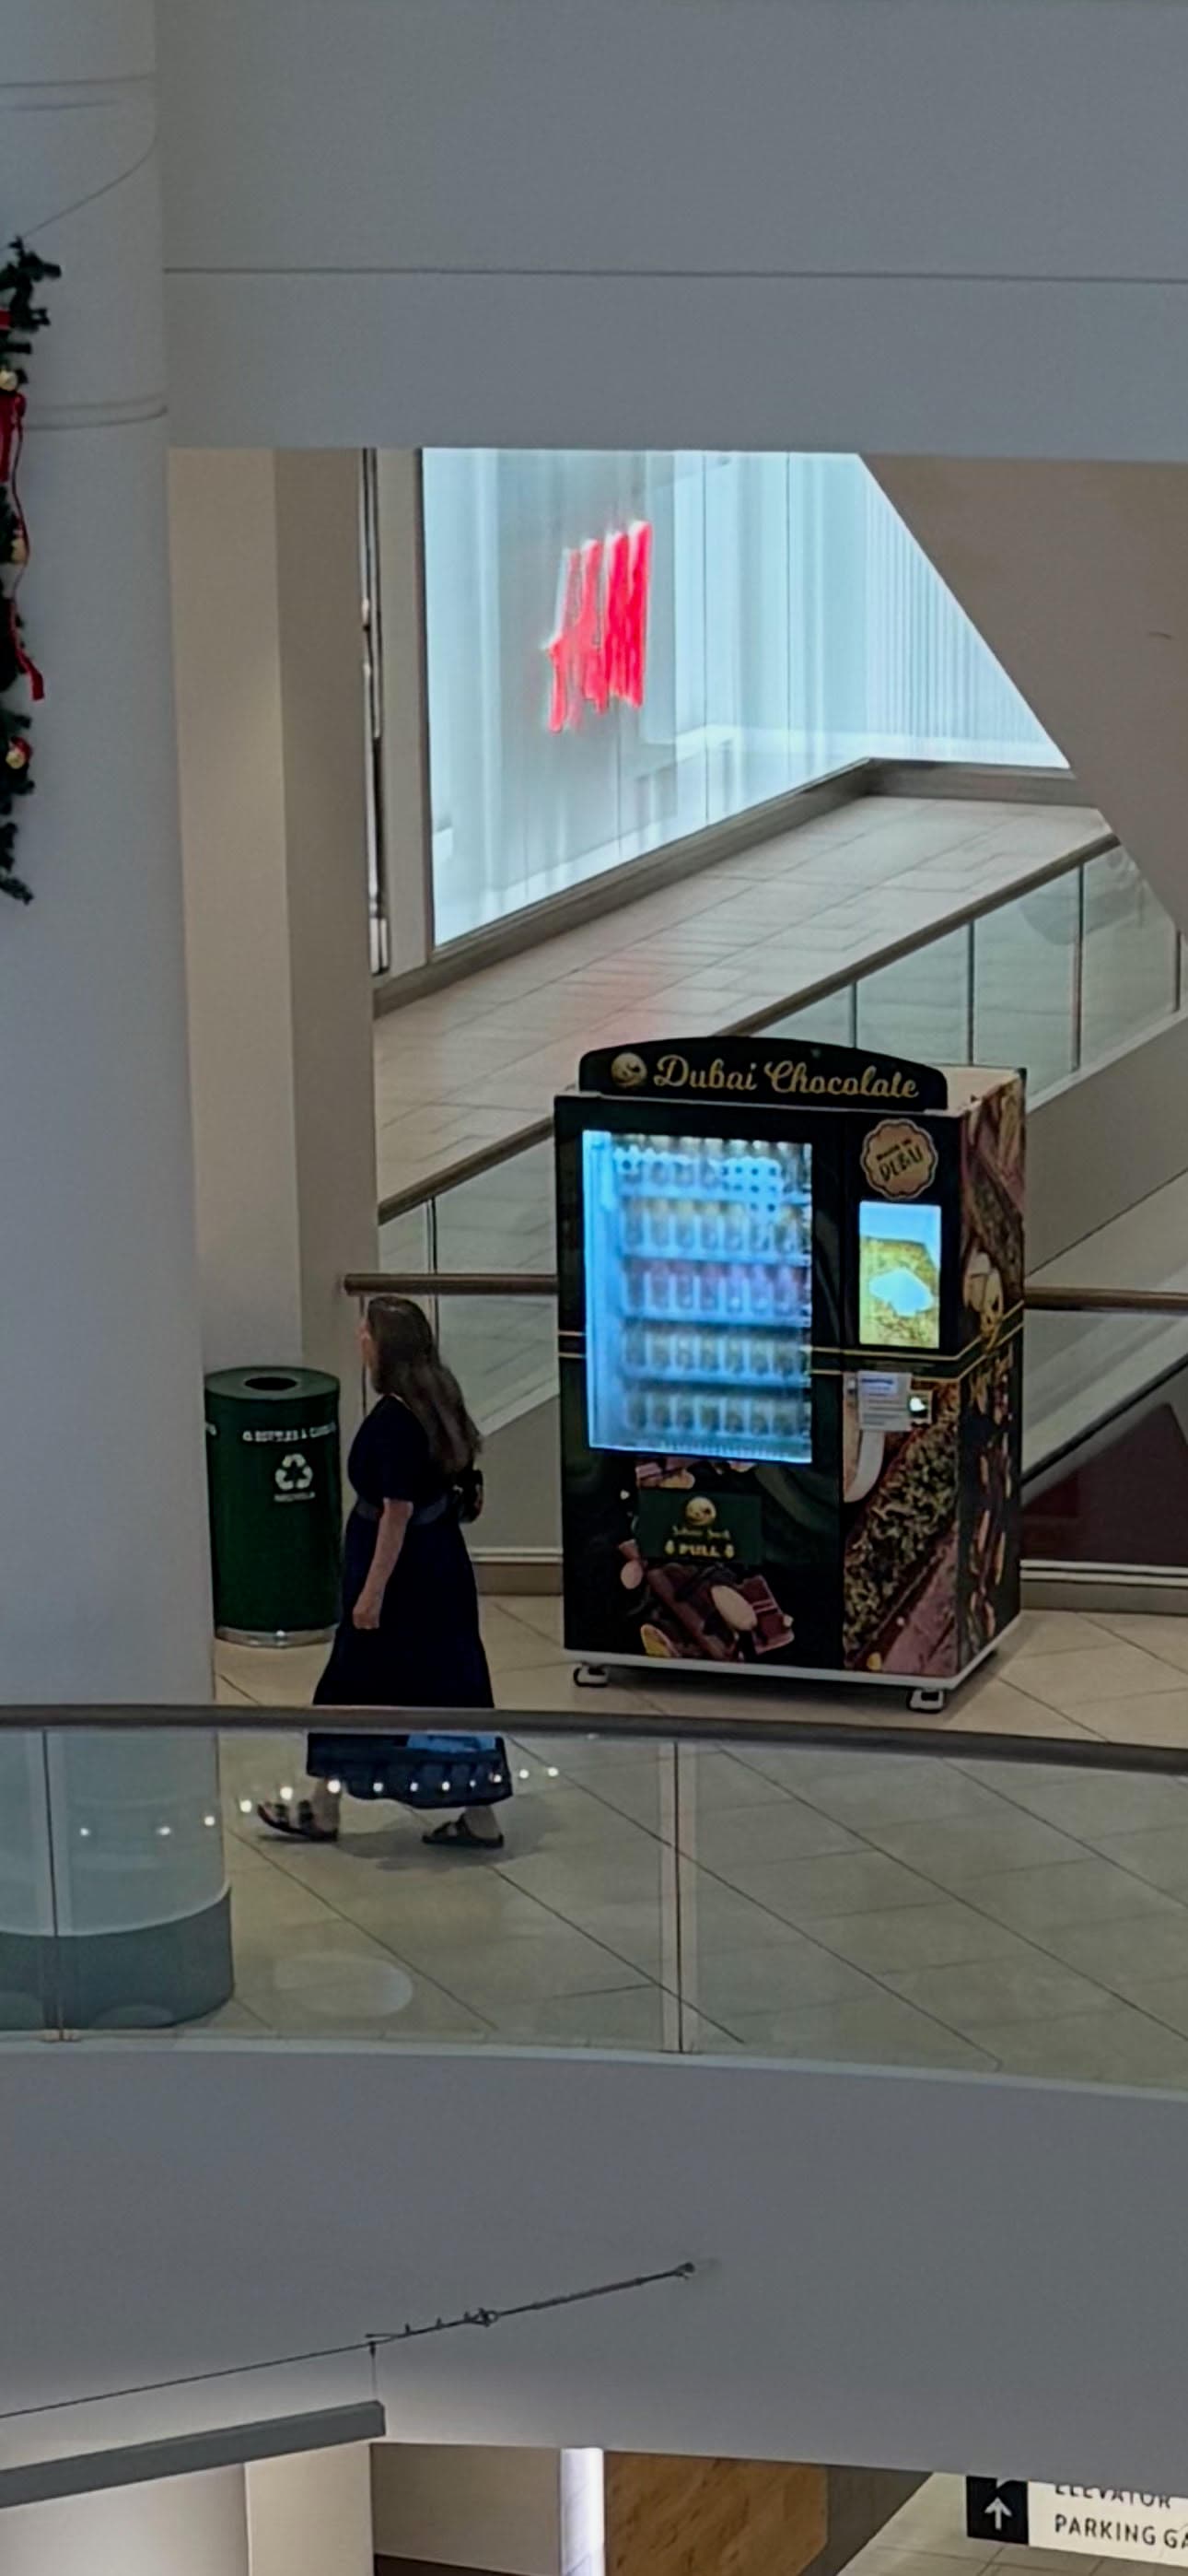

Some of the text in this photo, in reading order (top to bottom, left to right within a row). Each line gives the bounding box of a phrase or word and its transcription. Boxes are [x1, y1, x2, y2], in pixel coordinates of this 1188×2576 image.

[653, 1054, 919, 1098] Dubai Chocolate
[678, 1542, 722, 1558] PULL
[1055, 2512, 1156, 2546] PARKING
